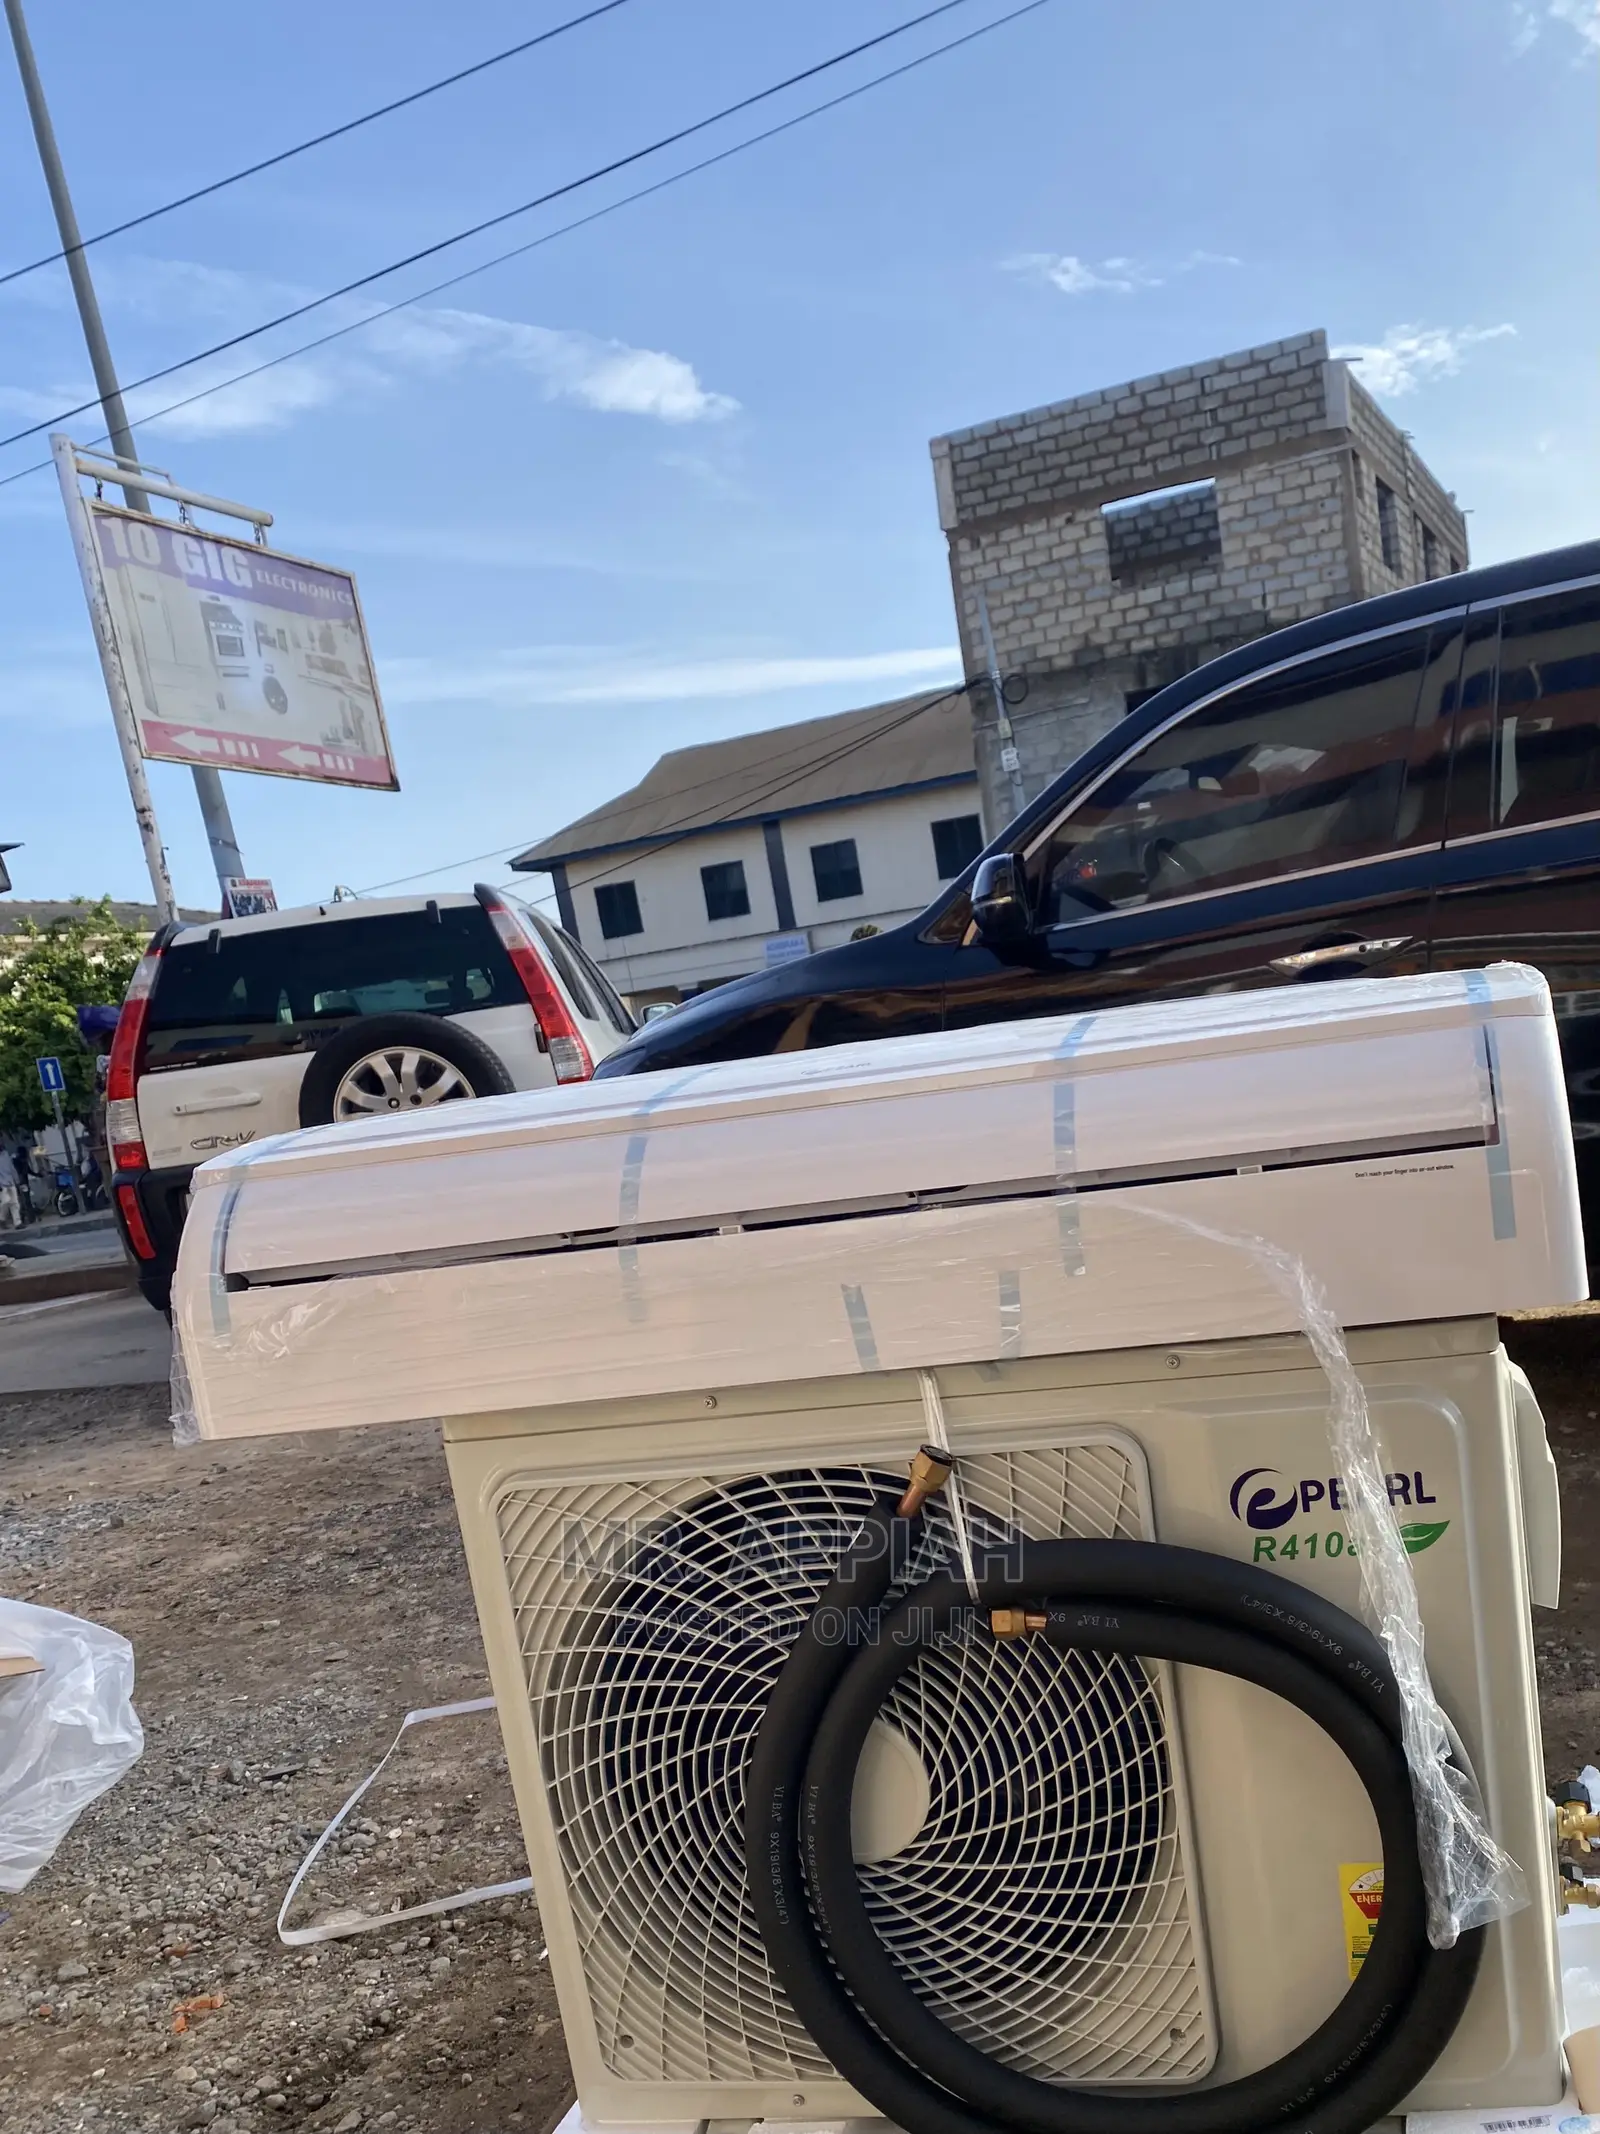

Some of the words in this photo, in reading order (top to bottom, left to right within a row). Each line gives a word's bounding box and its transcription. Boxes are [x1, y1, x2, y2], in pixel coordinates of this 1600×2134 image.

[101, 516, 162, 566] 10
[172, 532, 253, 588] GIG
[255, 569, 353, 606] ELECTRONICS
[1300, 1471, 1436, 1513] PERL
